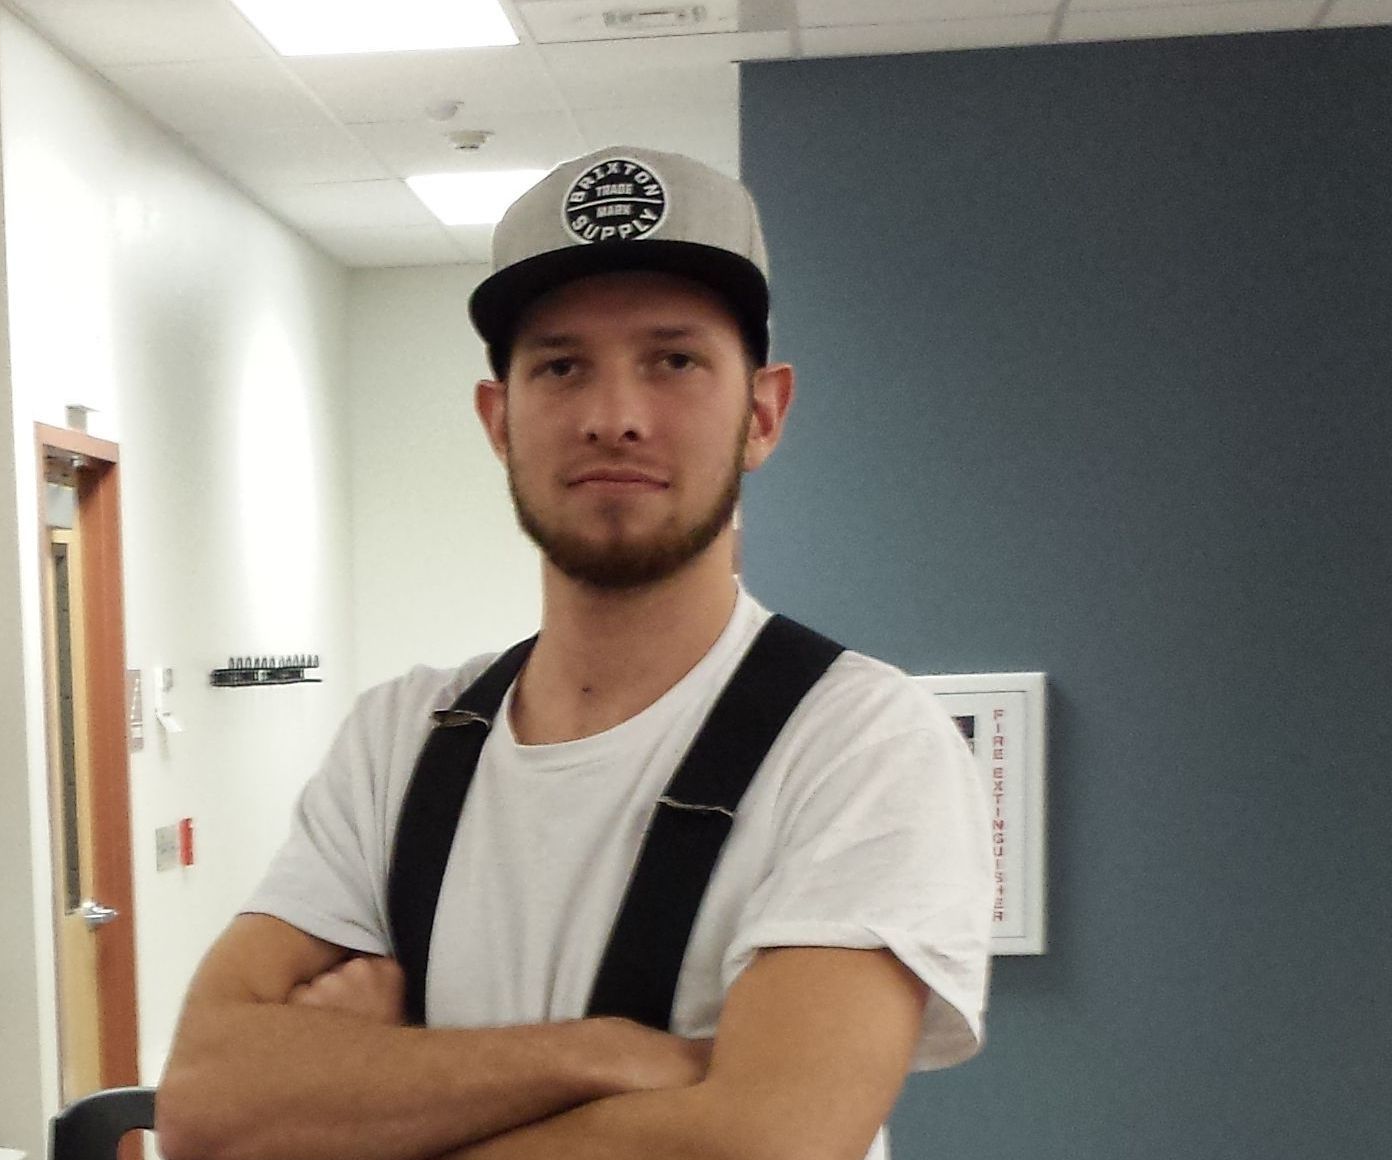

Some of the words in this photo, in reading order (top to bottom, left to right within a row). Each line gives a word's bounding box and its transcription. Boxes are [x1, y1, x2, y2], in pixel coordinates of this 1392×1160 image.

[569, 161, 662, 203] BRIXTON
[595, 183, 634, 197] TRADE
[571, 208, 659, 241] SUPPLY
[596, 204, 632, 218] MARK
[992, 708, 1005, 760] FIRE
